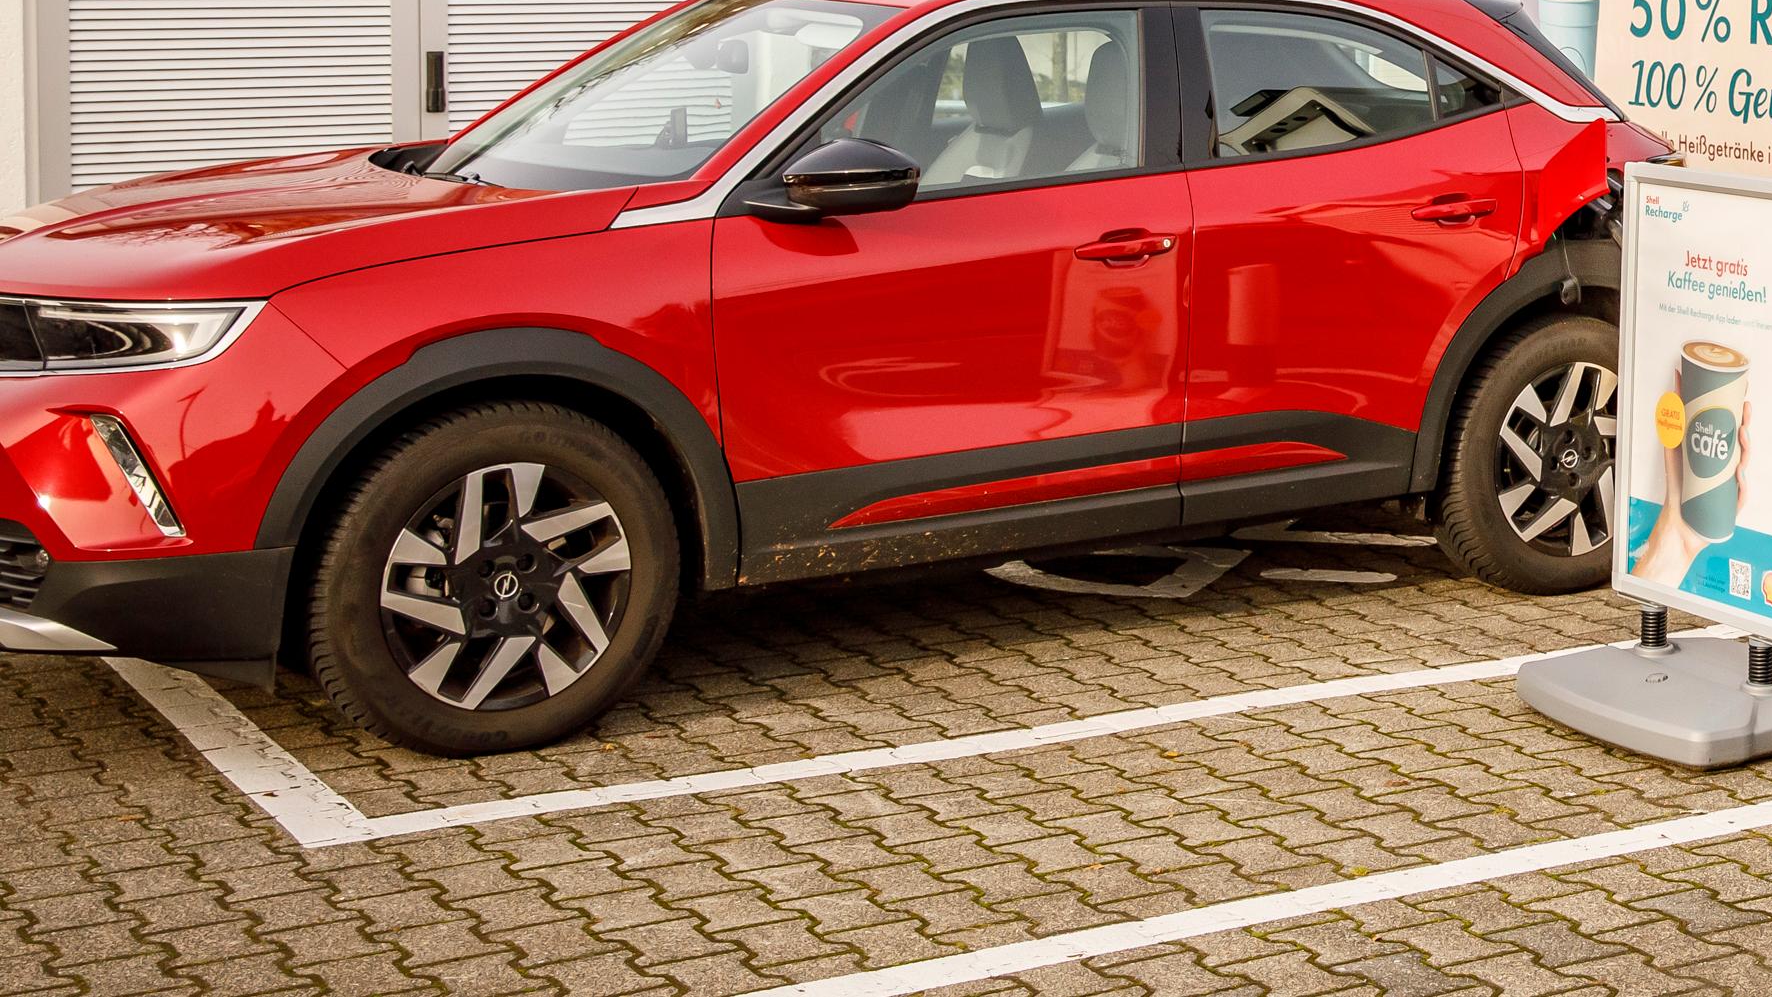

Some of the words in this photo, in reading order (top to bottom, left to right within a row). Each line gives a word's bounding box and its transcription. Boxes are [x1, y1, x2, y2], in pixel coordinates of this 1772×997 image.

[1678, 133, 1764, 163] Heißgetränke
[1645, 204, 1683, 223] Recharge
[1646, 195, 1660, 205] Shell
[1685, 250, 1713, 271] Jetzt
[1716, 258, 1748, 277] gratis
[1667, 270, 1705, 293] Kaffee
[1708, 280, 1767, 304] genießen!
[1695, 421, 1713, 435] Shell
[1691, 429, 1729, 460] café
